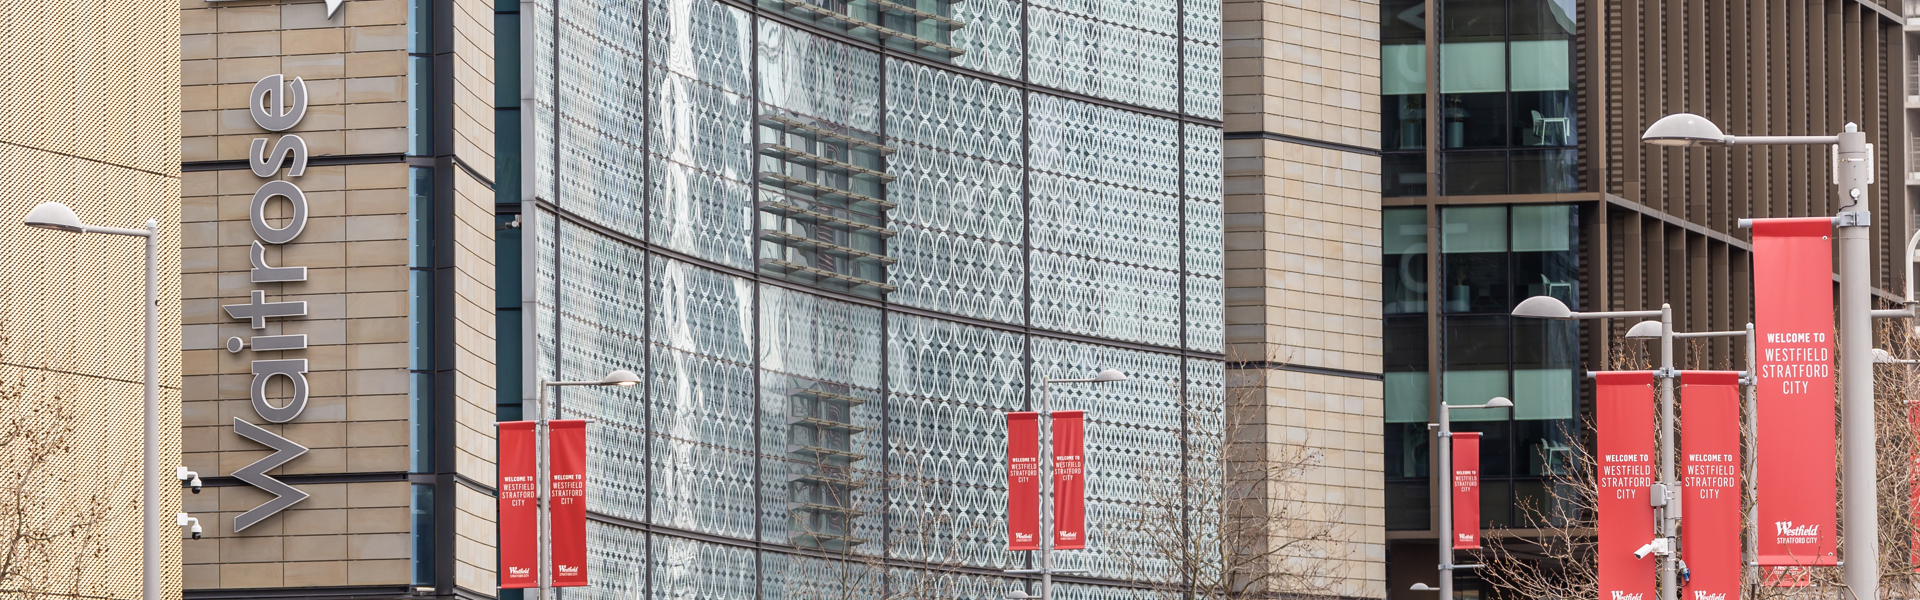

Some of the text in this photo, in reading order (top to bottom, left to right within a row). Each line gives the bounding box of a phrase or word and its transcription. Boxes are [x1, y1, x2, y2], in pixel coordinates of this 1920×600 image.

[222, 74, 310, 533] Waitrose
[1767, 333, 1826, 343] WELCOME TO
[1765, 348, 1828, 362] WESTFIELD
[1762, 364, 1829, 378] STRATFORD
[1783, 381, 1809, 394] CITY
[1689, 454, 1733, 462] WELCOME TO
[1604, 465, 1651, 476] WESTFIELD
[1687, 465, 1735, 475] WESTFIELD
[503, 483, 534, 491] WESTFIELD
[1601, 477, 1651, 488] STRATFORD
[1685, 477, 1735, 488] STRATFORD
[502, 491, 534, 499] STRATFORD
[1616, 489, 1636, 499] CITY
[1700, 489, 1720, 499] CITY
[512, 499, 525, 507] CITY
[1775, 521, 1819, 536] Westfield
